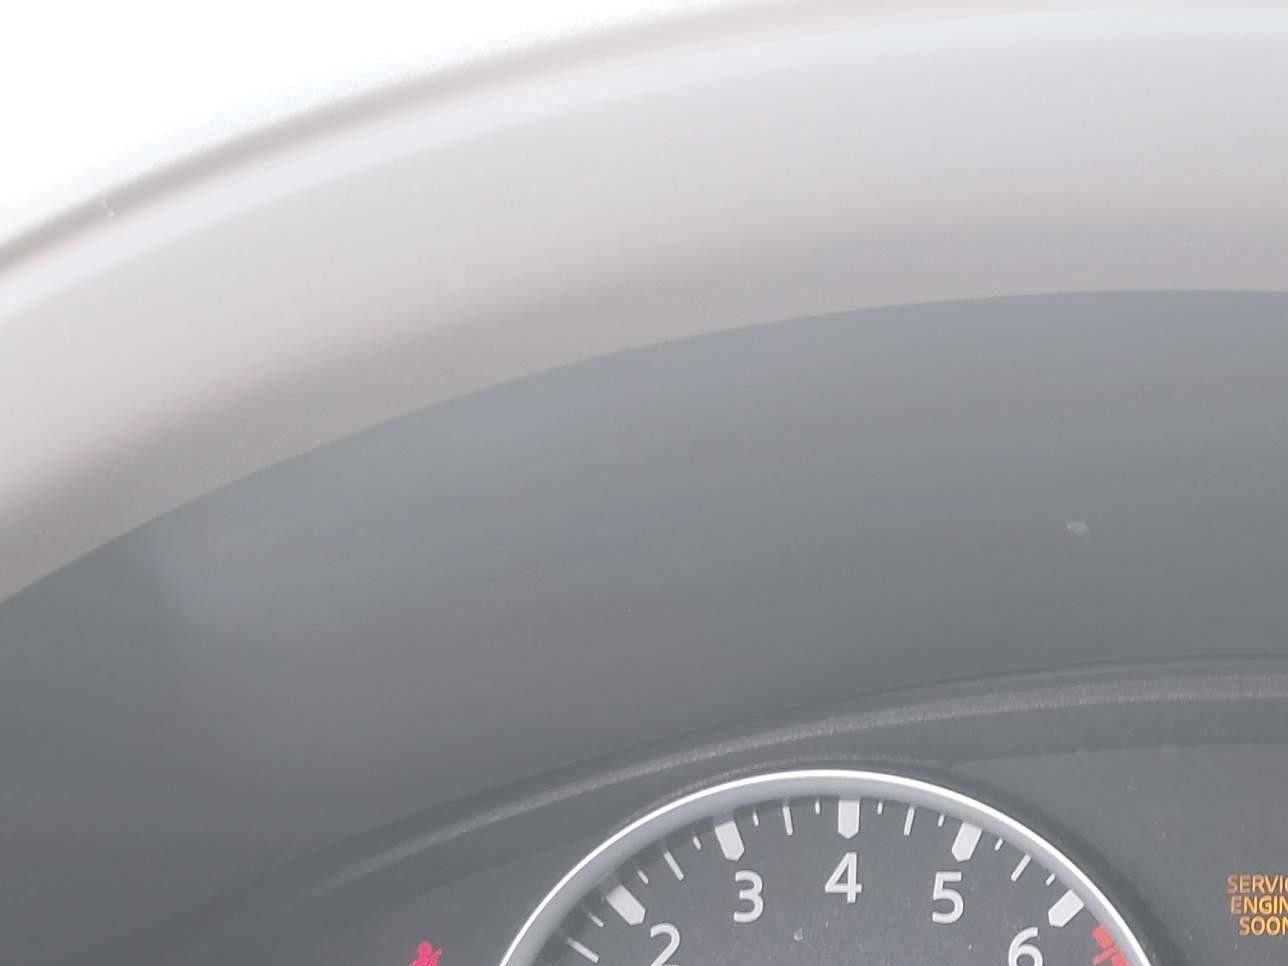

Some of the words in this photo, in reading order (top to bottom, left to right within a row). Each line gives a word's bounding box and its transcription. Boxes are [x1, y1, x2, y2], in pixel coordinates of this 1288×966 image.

[733, 872, 764, 923] 3
[825, 853, 861, 903] 4
[932, 872, 965, 924] 5
